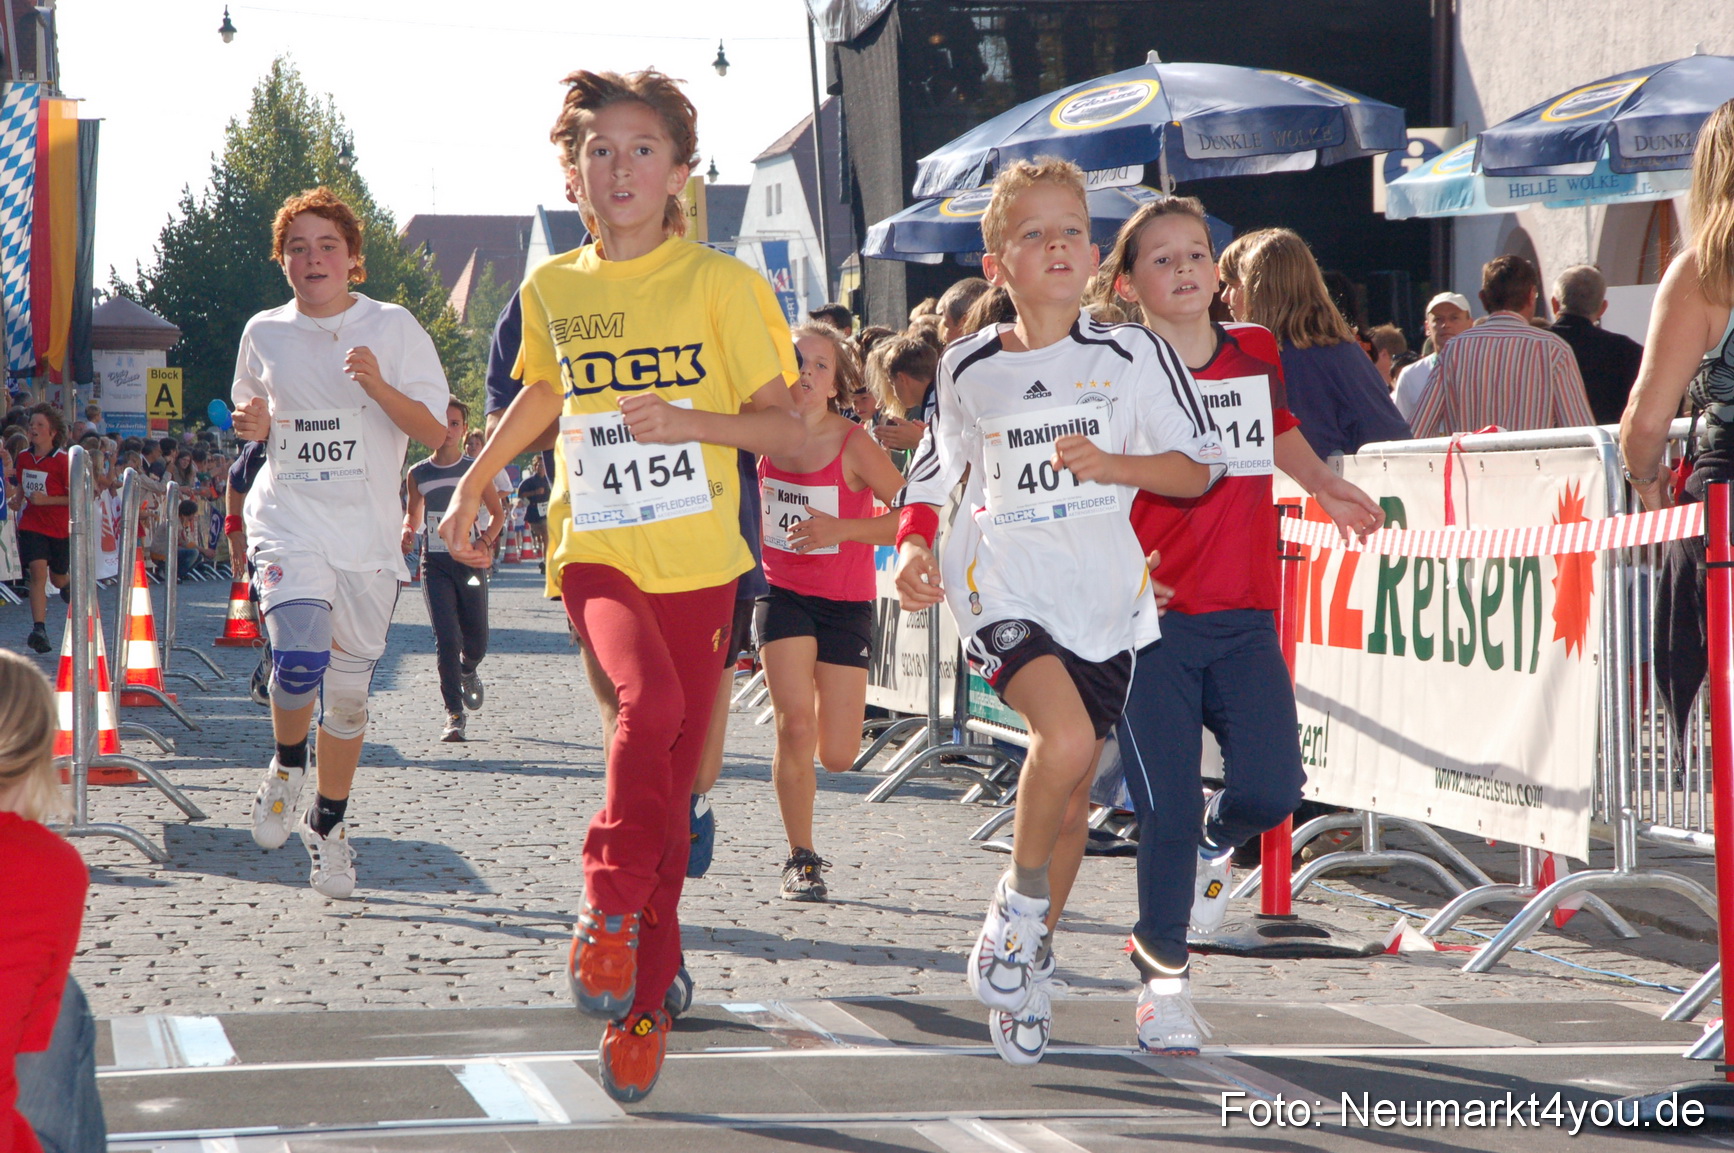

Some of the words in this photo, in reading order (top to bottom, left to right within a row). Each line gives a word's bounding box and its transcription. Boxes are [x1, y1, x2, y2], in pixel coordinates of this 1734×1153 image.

[1200, 132, 1264, 151] DUNKLE
[1634, 132, 1694, 152] DUNKL
[1509, 178, 1558, 199] HELLE
[1567, 174, 1620, 192] WOLKE
[548, 312, 625, 346] EAM
[151, 369, 179, 380] Block
[154, 383, 175, 408] A
[1023, 391, 1052, 400] adidas
[294, 417, 341, 432] Manuel
[1007, 417, 1101, 450] Maximilia
[1216, 419, 1265, 448] 14
[280, 439, 287, 450] J
[298, 440, 357, 463] 4067
[574, 459, 584, 477] J
[603, 449, 696, 495] 4154
[993, 462, 1001, 480] J
[1018, 459, 1082, 495] 40
[1228, 459, 1272, 470] PFLEIDERER
[26, 481, 45, 492] 4082
[778, 488, 809, 506] Katrin
[575, 509, 625, 526] BOCK
[655, 493, 710, 513] PFLEIDERER
[765, 505, 771, 515] J
[994, 508, 1036, 526] BOCK
[1067, 495, 1117, 512] PFLEIDERER
[1278, 497, 1364, 650] RZ
[1368, 496, 1543, 675] Reisen
[1435, 767, 1544, 810] www.merz-reisen.com
